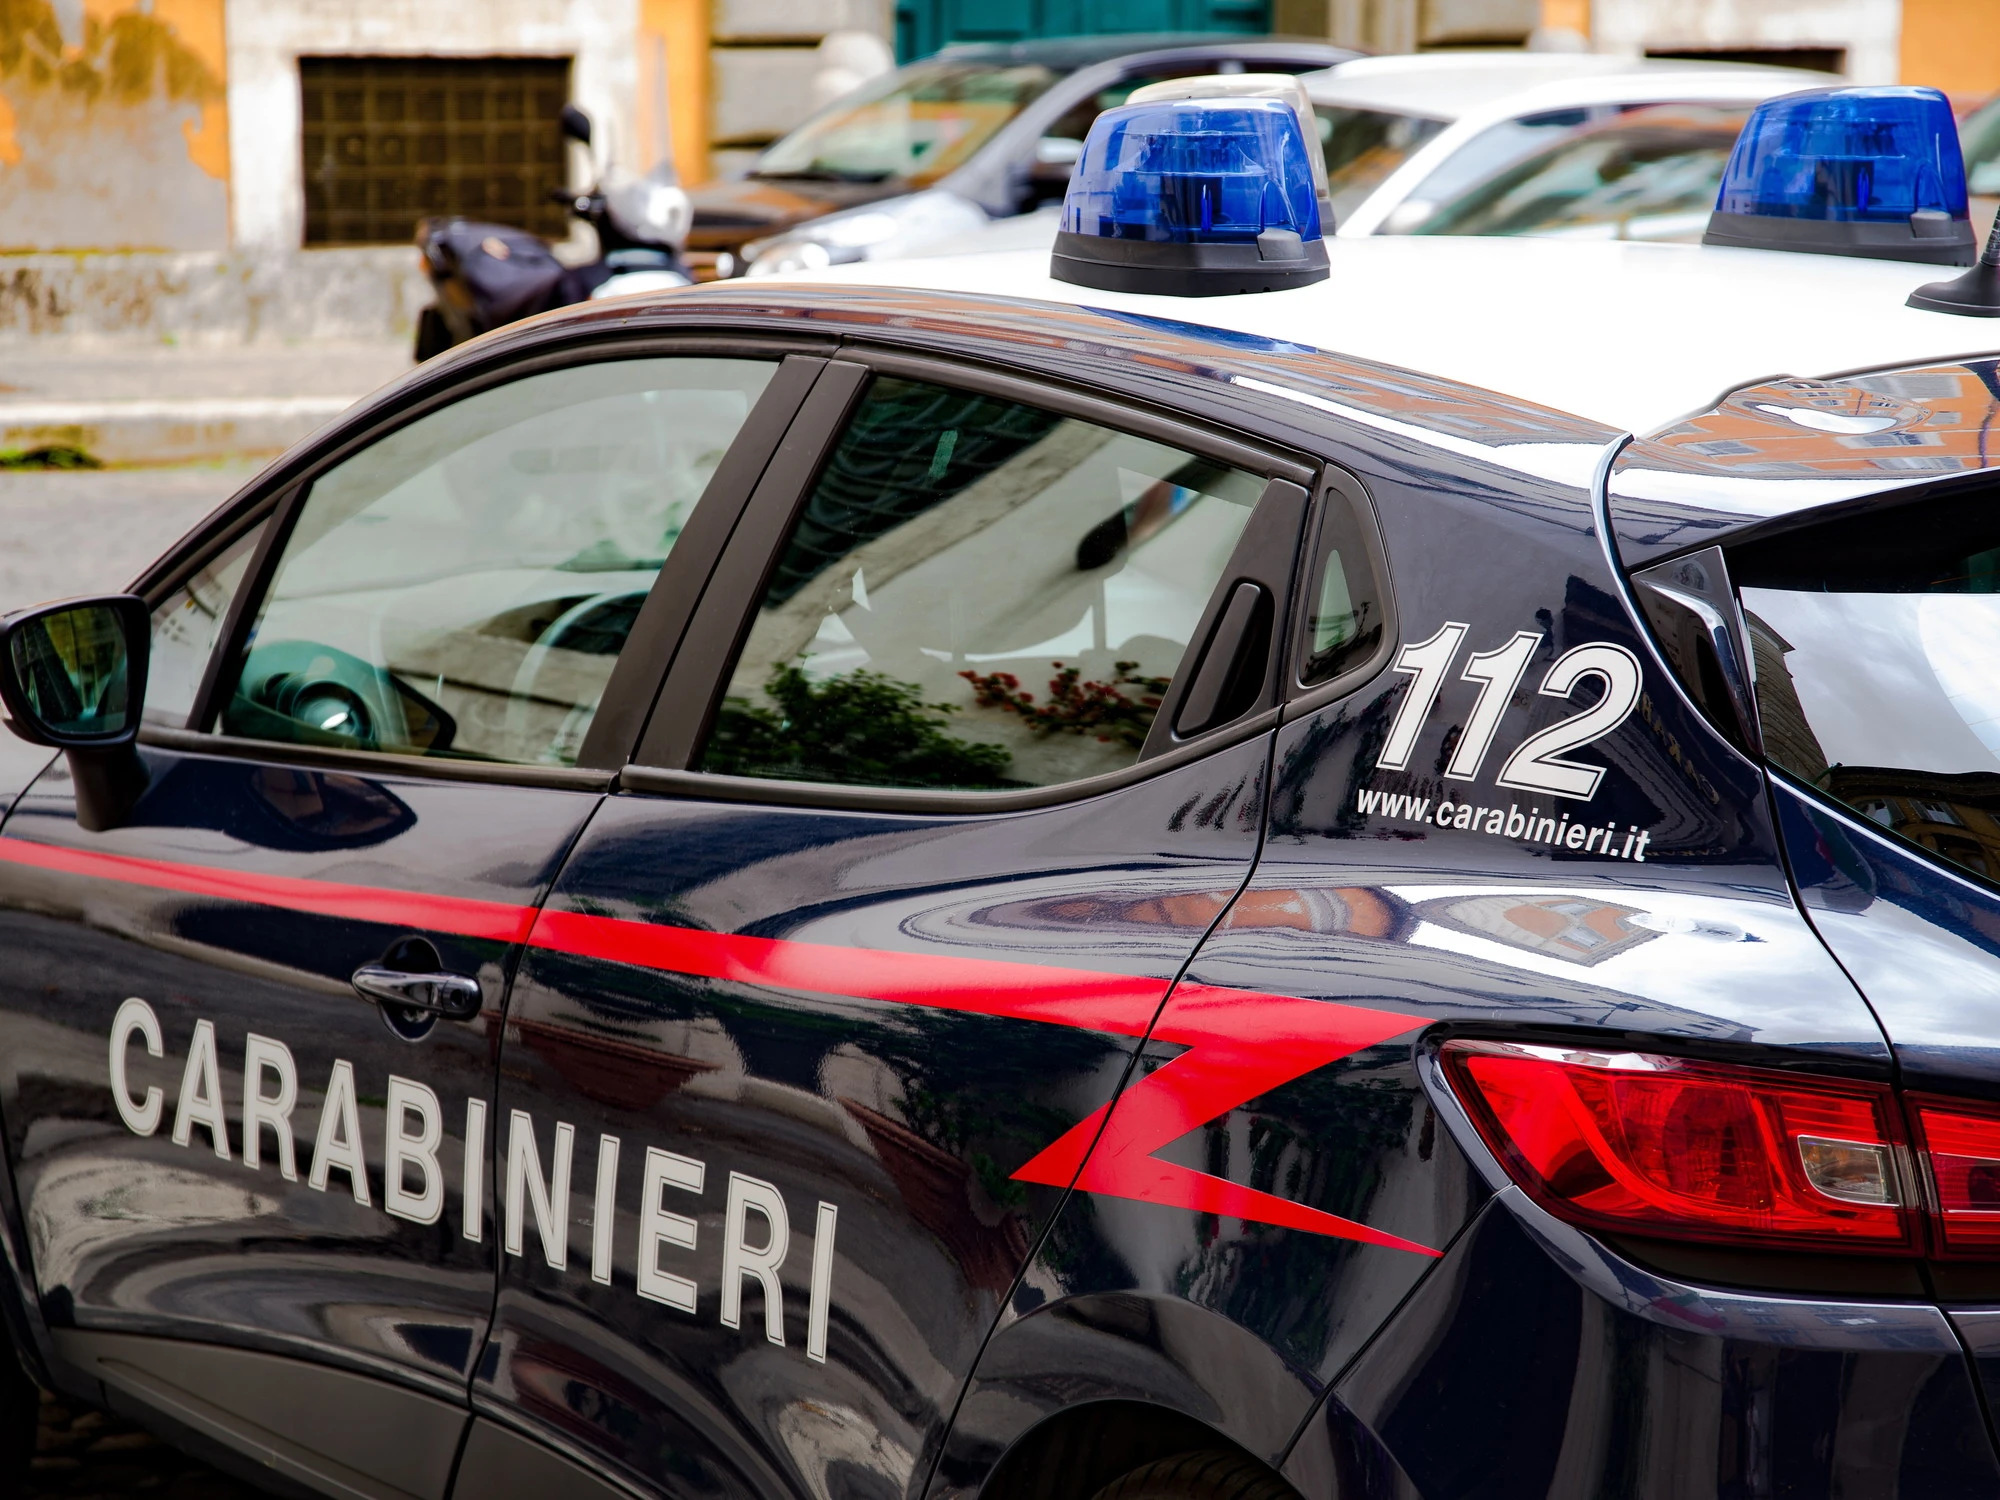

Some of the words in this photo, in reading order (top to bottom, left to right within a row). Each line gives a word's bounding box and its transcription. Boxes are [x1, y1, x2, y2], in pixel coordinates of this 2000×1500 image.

[1375, 621, 1643, 802] 112
[1357, 789, 1651, 862] www.carabinieri.it
[109, 998, 838, 1363] CARABINIERI
